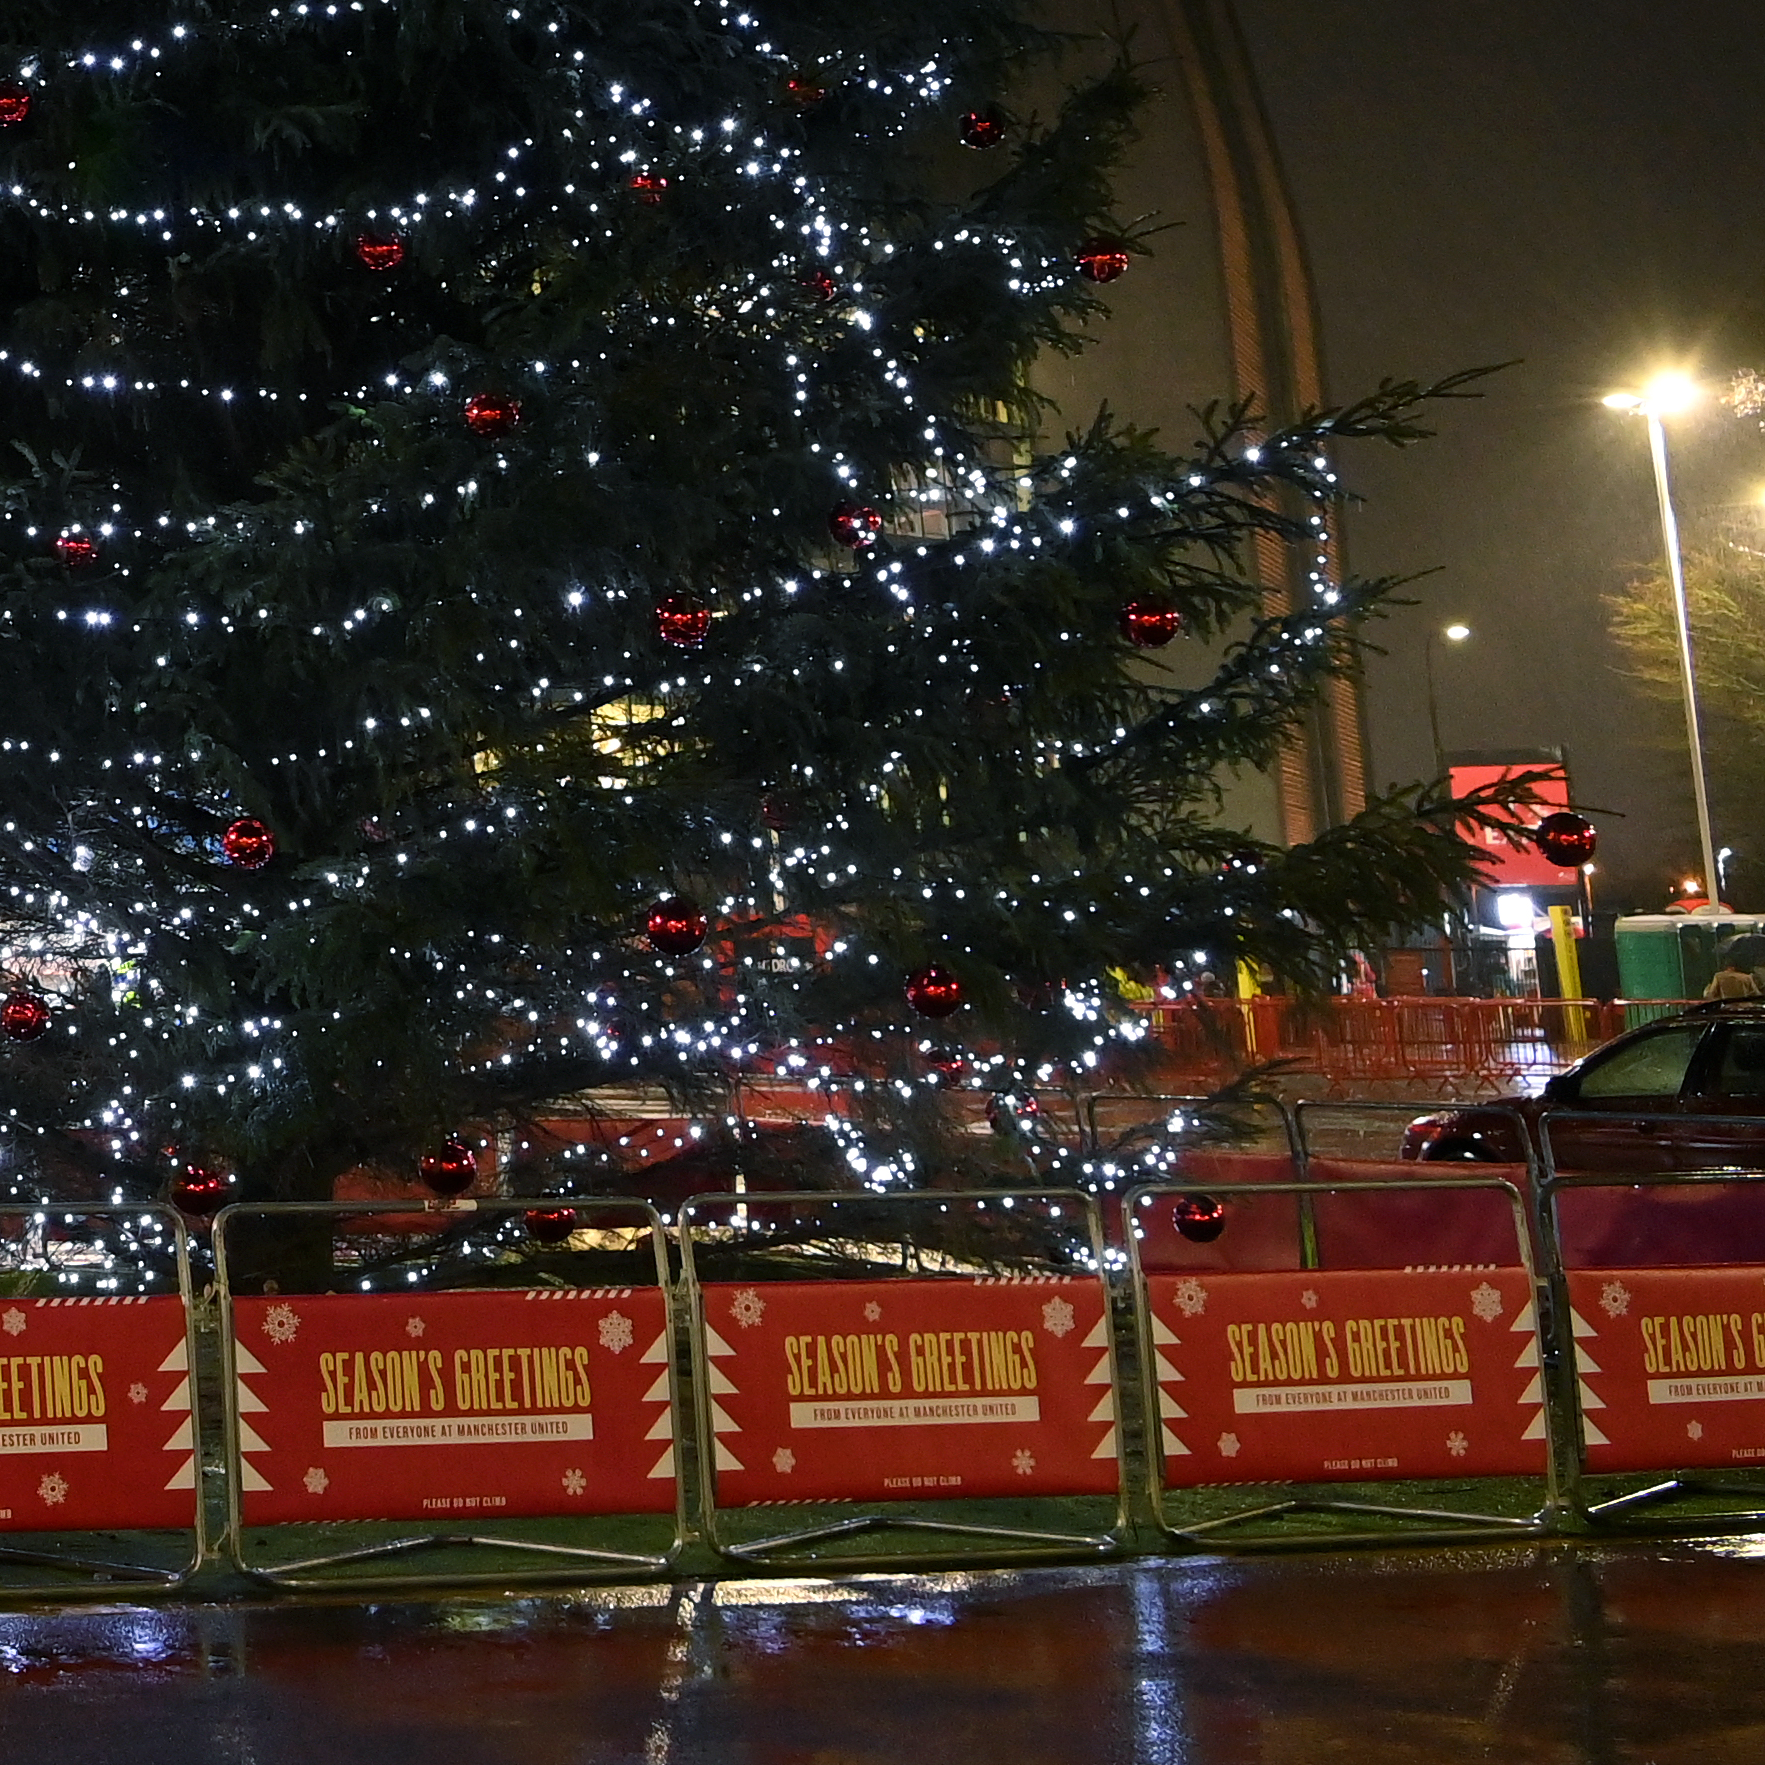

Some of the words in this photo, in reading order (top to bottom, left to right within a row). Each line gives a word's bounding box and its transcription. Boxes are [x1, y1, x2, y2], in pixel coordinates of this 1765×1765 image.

[1226, 1320, 1340, 1382] SEASON'S
[1345, 1316, 1469, 1378] GREETINGS
[1640, 1313, 1746, 1374] SEASON'S
[784, 1333, 902, 1396] SEASON'S
[909, 1330, 1037, 1393] GREETINGS
[319, 1350, 445, 1414] SEASON'S
[454, 1346, 591, 1410] GREETINGS
[1668, 1384, 1694, 1397] FROM
[1696, 1383, 1742, 1396] EVERYONE
[1255, 1393, 1282, 1407] FROM
[1285, 1391, 1334, 1406] EVERYONE
[1337, 1390, 1349, 1403] AT
[1351, 1388, 1415, 1403] MANCHESTER
[1416, 1387, 1451, 1401] UNITED
[813, 1408, 841, 1422] FROM
[845, 1406, 896, 1421] EVERYONE
[898, 1406, 910, 1419] AT
[913, 1404, 979, 1419] MANCHESTER
[981, 1403, 1017, 1417] UNITED
[40, 1431, 81, 1446] UNITED
[348, 1427, 378, 1441] FROM
[382, 1425, 437, 1440] EVERYONE
[440, 1424, 454, 1438] AT
[457, 1422, 528, 1437] MANCHESTER
[530, 1421, 569, 1436] UNITED
